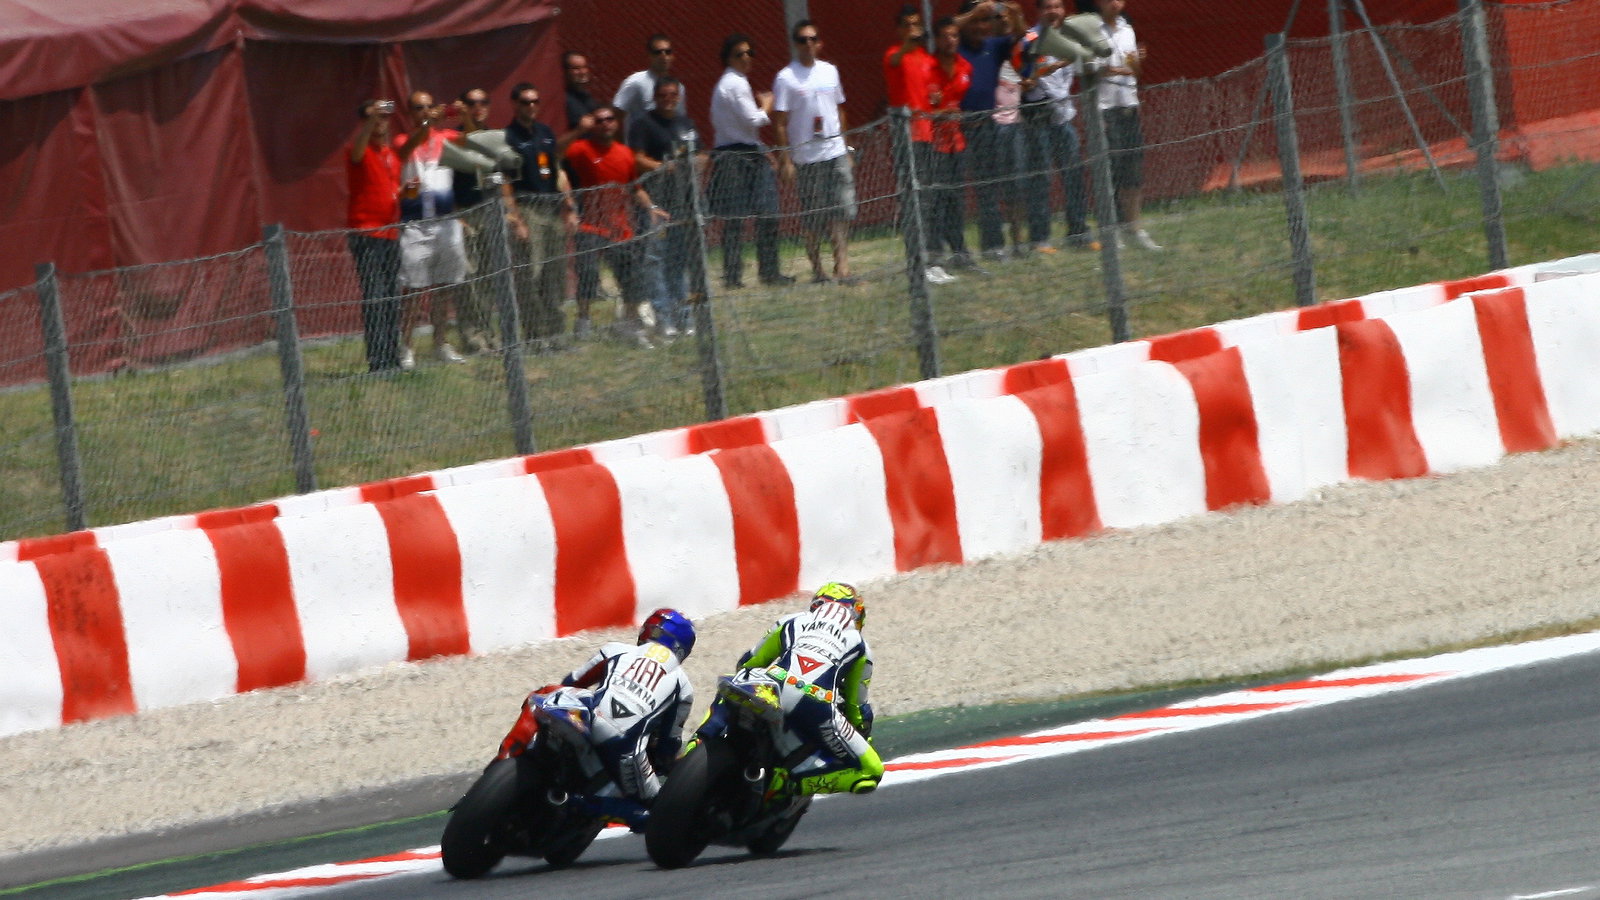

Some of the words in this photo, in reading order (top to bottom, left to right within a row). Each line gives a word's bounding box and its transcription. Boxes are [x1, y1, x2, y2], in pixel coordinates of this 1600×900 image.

[801, 620, 848, 647] YAMAHA
[621, 657, 667, 692] FIAT
[611, 677, 656, 711] YAMAHA
